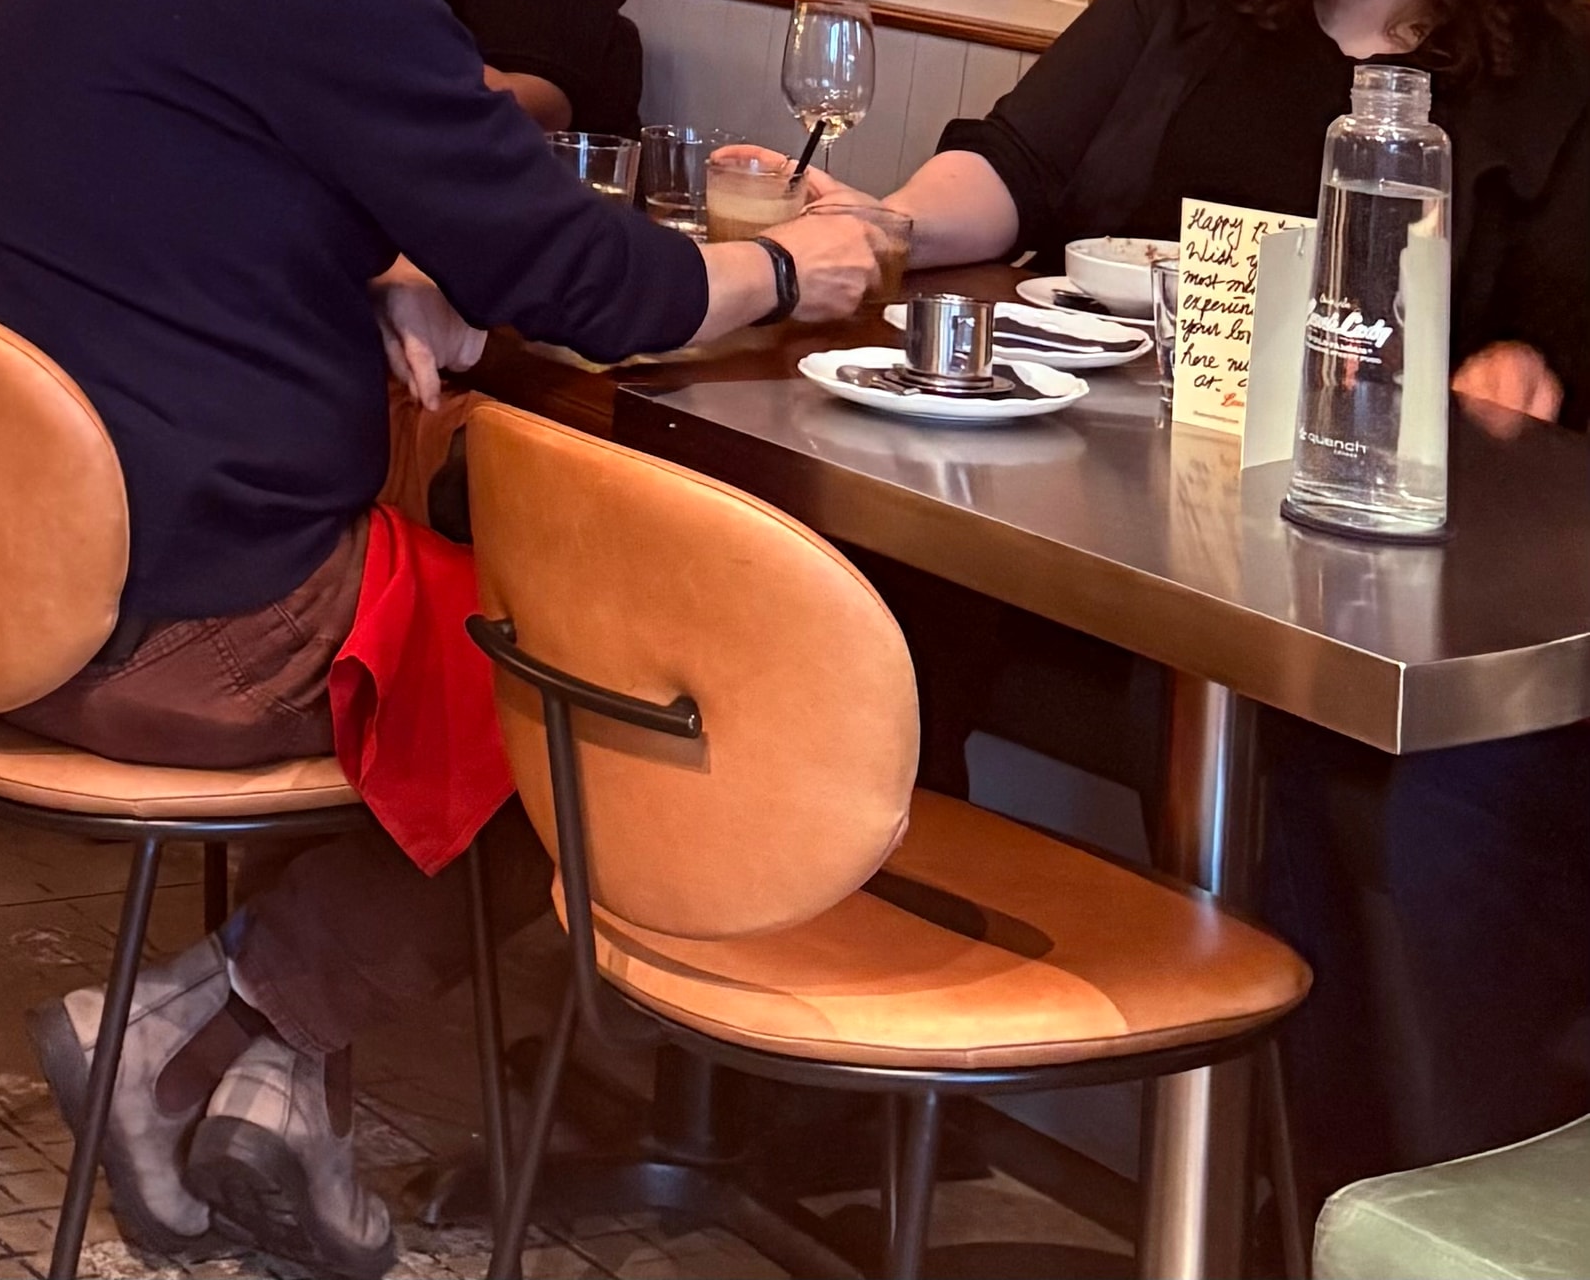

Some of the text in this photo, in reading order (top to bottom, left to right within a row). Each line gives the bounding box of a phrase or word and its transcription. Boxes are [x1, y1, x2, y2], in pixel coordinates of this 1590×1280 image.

[1187, 207, 1243, 251] Happy
[1186, 238, 1239, 268] Wish
[1183, 270, 1226, 290] most
[1180, 318, 1221, 343] your
